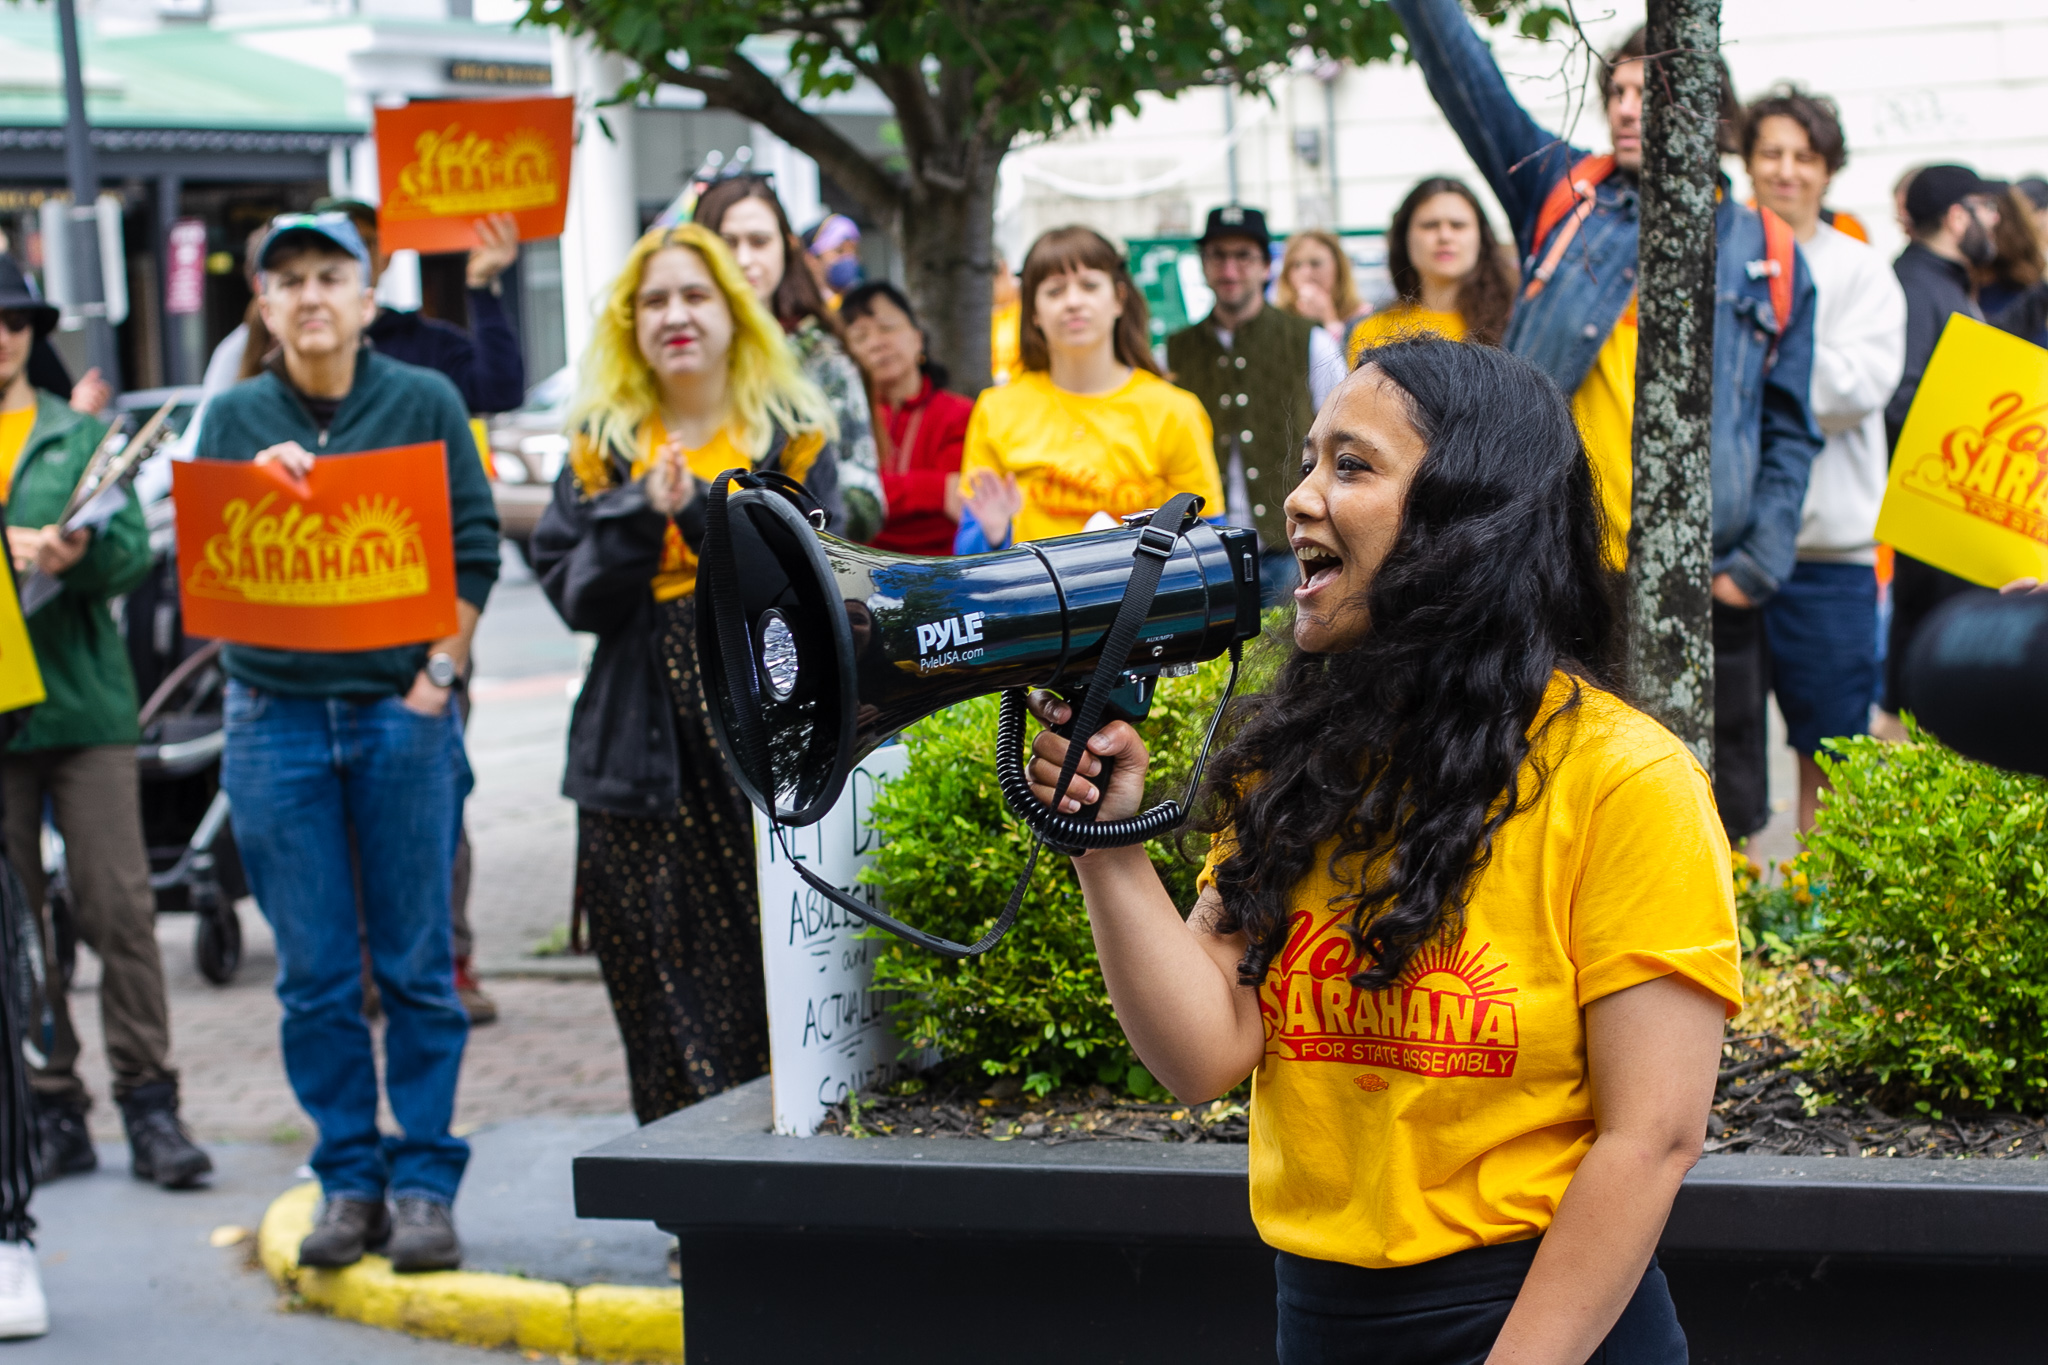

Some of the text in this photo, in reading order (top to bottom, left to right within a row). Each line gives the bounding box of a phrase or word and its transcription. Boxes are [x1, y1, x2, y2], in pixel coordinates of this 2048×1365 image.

[222, 490, 324, 547] Vote
[208, 534, 422, 584] SARAHANA
[920, 647, 984, 674] PyleUSA.com
[1260, 972, 1517, 1046] SARAHANA
[1301, 1042, 1514, 1074] FOR STATE ASSEMBLY
